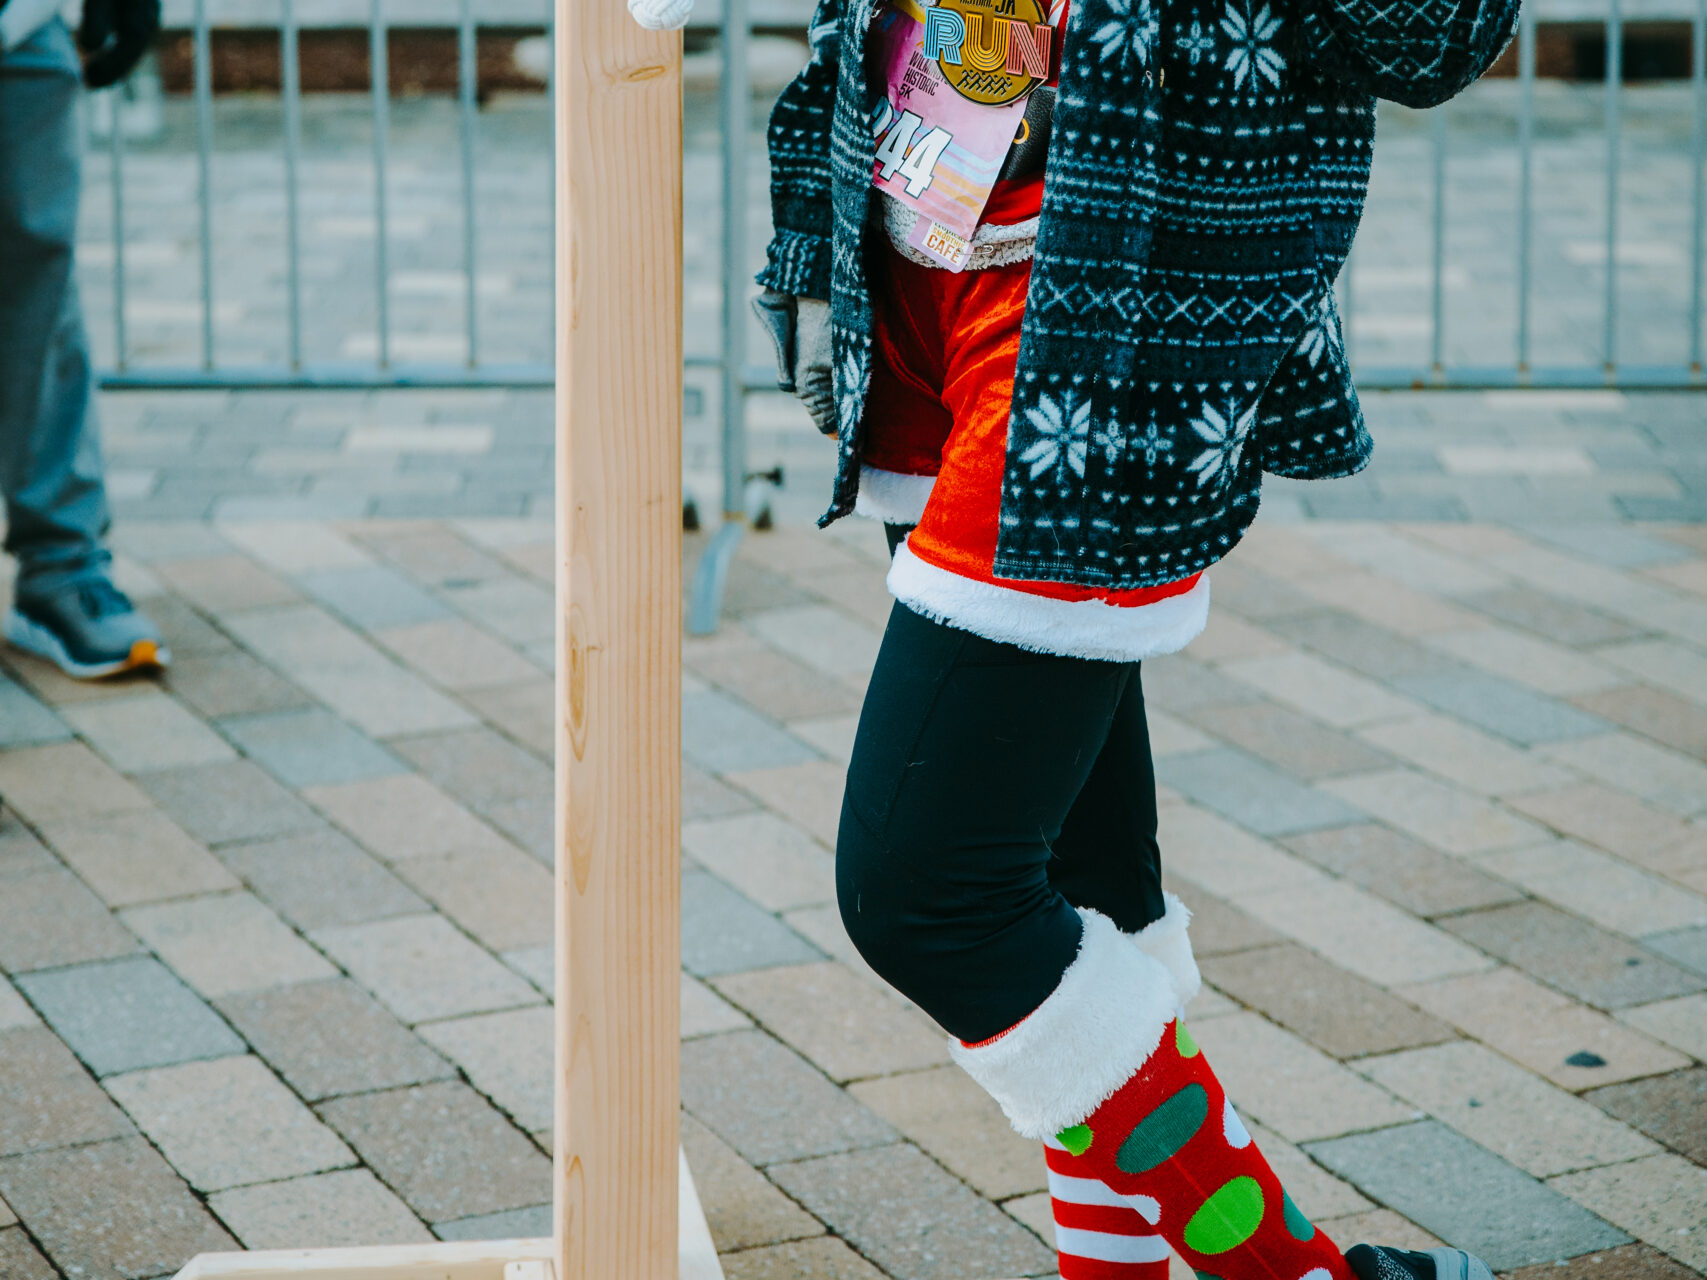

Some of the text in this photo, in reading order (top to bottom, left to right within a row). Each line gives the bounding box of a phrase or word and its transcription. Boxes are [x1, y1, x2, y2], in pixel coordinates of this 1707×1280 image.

[923, 5, 1053, 80] RUN
[899, 83, 914, 100] 5K
[903, 66, 939, 96] HISTORIC
[932, 227, 965, 248] SMOOTHIE
